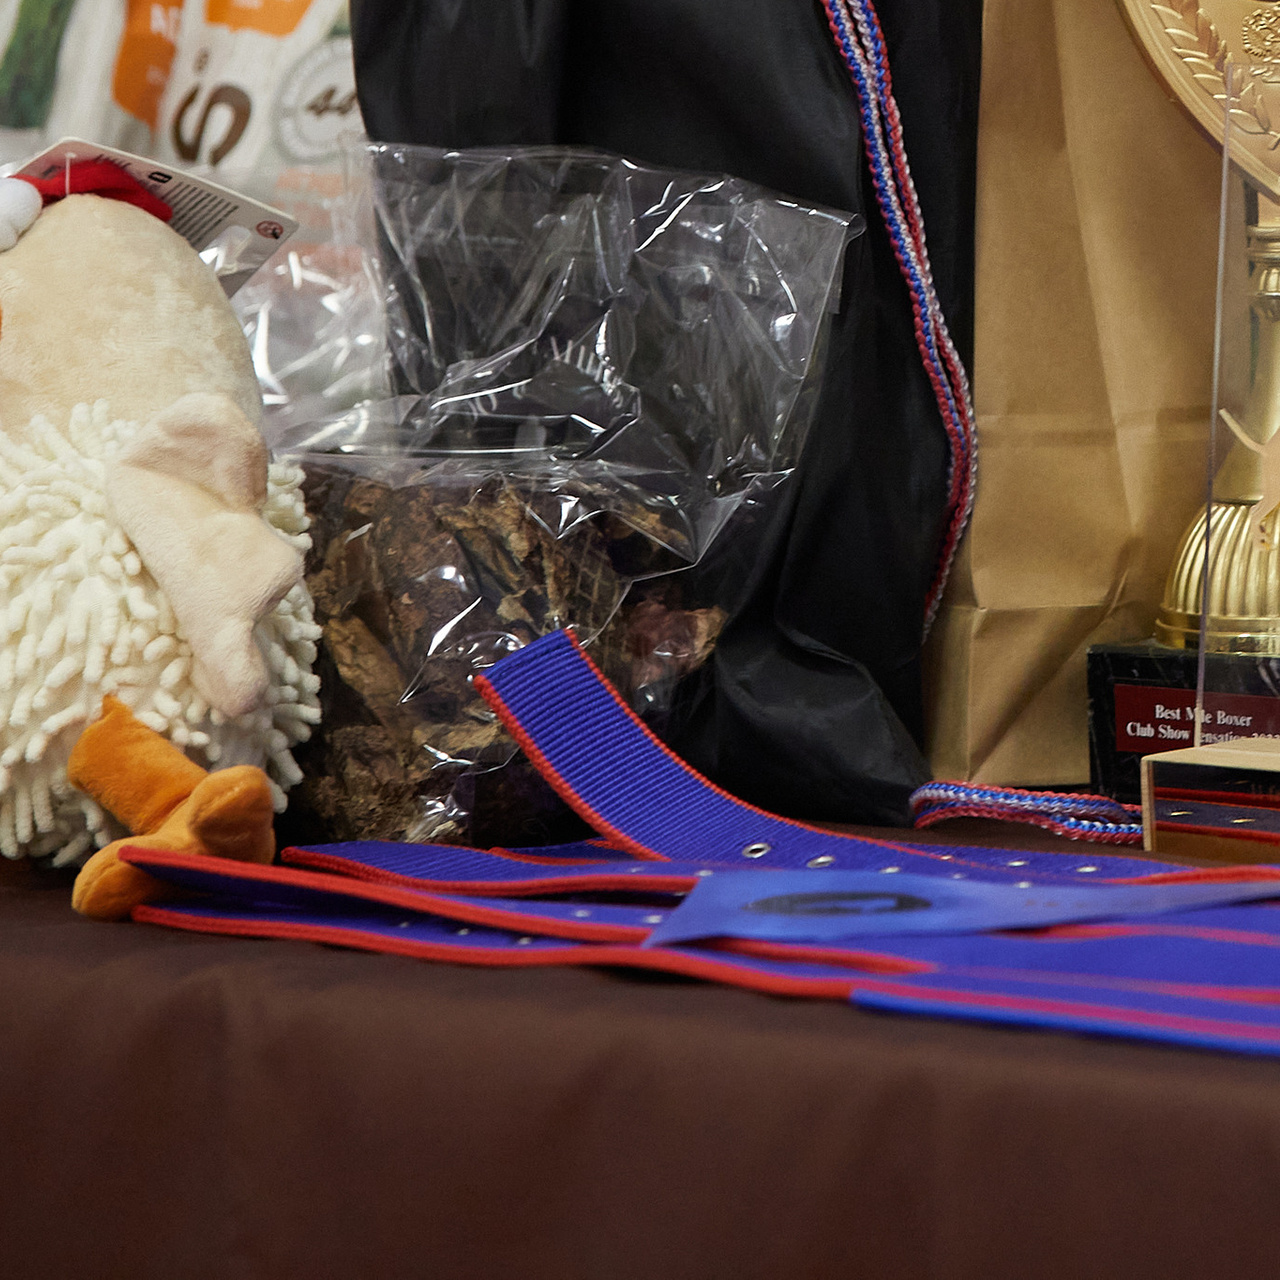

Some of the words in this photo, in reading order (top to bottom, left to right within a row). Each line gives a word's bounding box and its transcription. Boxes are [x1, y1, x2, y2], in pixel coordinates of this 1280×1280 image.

[1155, 704, 1182, 721] Best
[1217, 710, 1253, 727] Boxer
[1126, 721, 1155, 738] Club
[1157, 723, 1192, 741] Show
